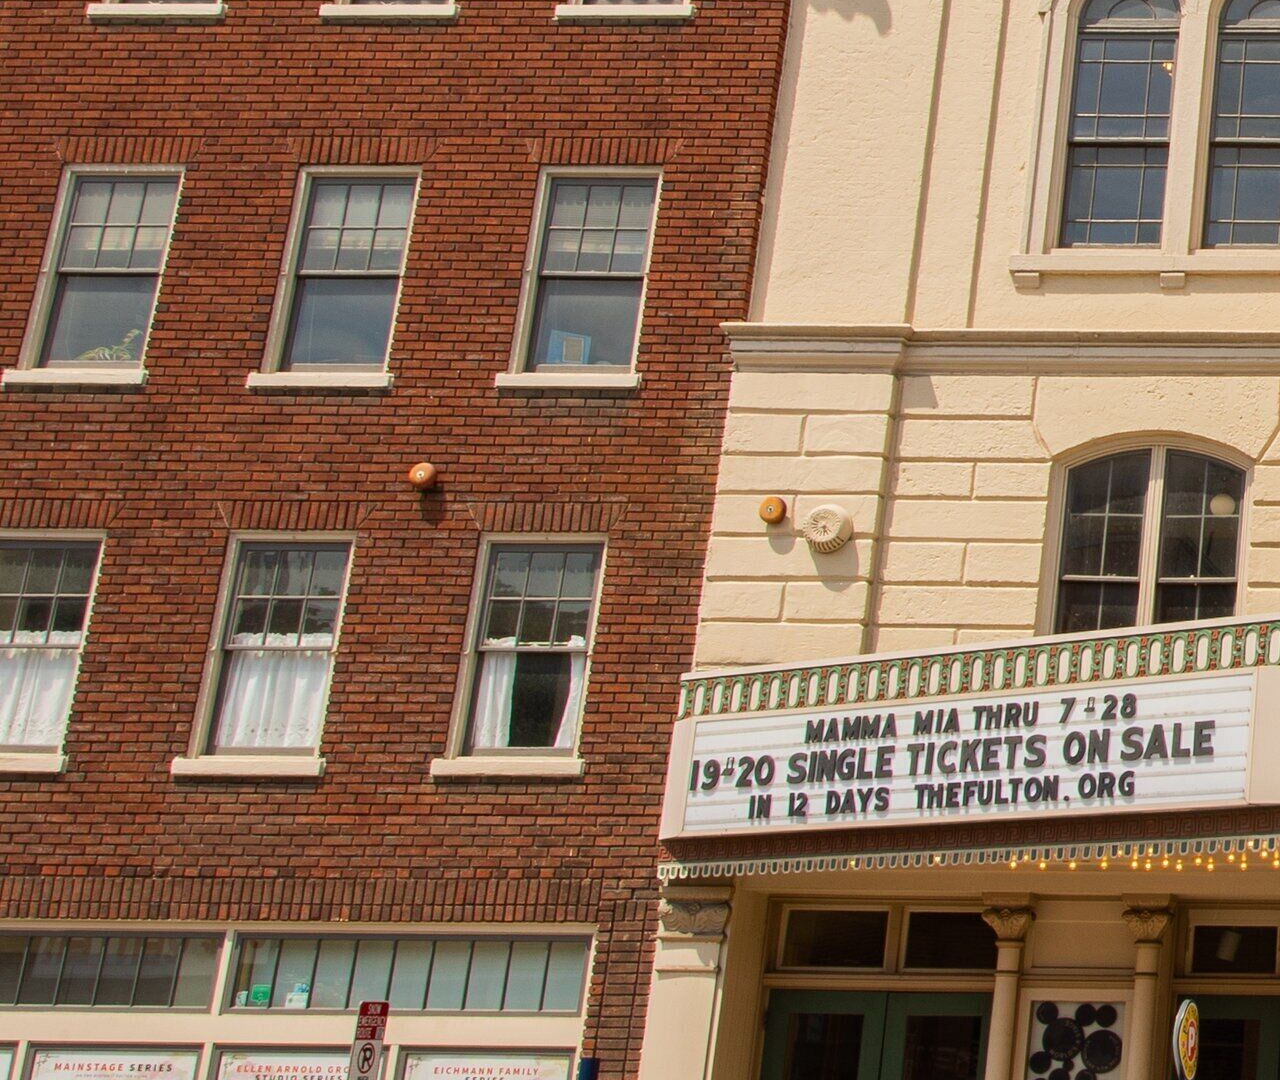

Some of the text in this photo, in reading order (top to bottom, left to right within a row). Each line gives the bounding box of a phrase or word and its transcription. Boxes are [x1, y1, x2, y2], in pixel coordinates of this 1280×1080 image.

[804, 713, 898, 744] MAMMA
[912, 708, 961, 736] MIA
[973, 701, 1040, 732] THRU
[786, 745, 896, 784] SINGLE
[907, 734, 1048, 776] TICKETS
[1062, 728, 1111, 765] ON
[1120, 720, 1216, 762] SALE
[747, 794, 772, 820] IN
[788, 791, 809, 817] 12
[825, 787, 890, 815] DAYS
[54, 1063, 173, 1072] MAINSTAGE SERIES
[236, 1065, 275, 1073] ELLEN
[276, 1065, 322, 1074] ARNOLD
[433, 1066, 539, 1075] EICHMANN FAMILY
